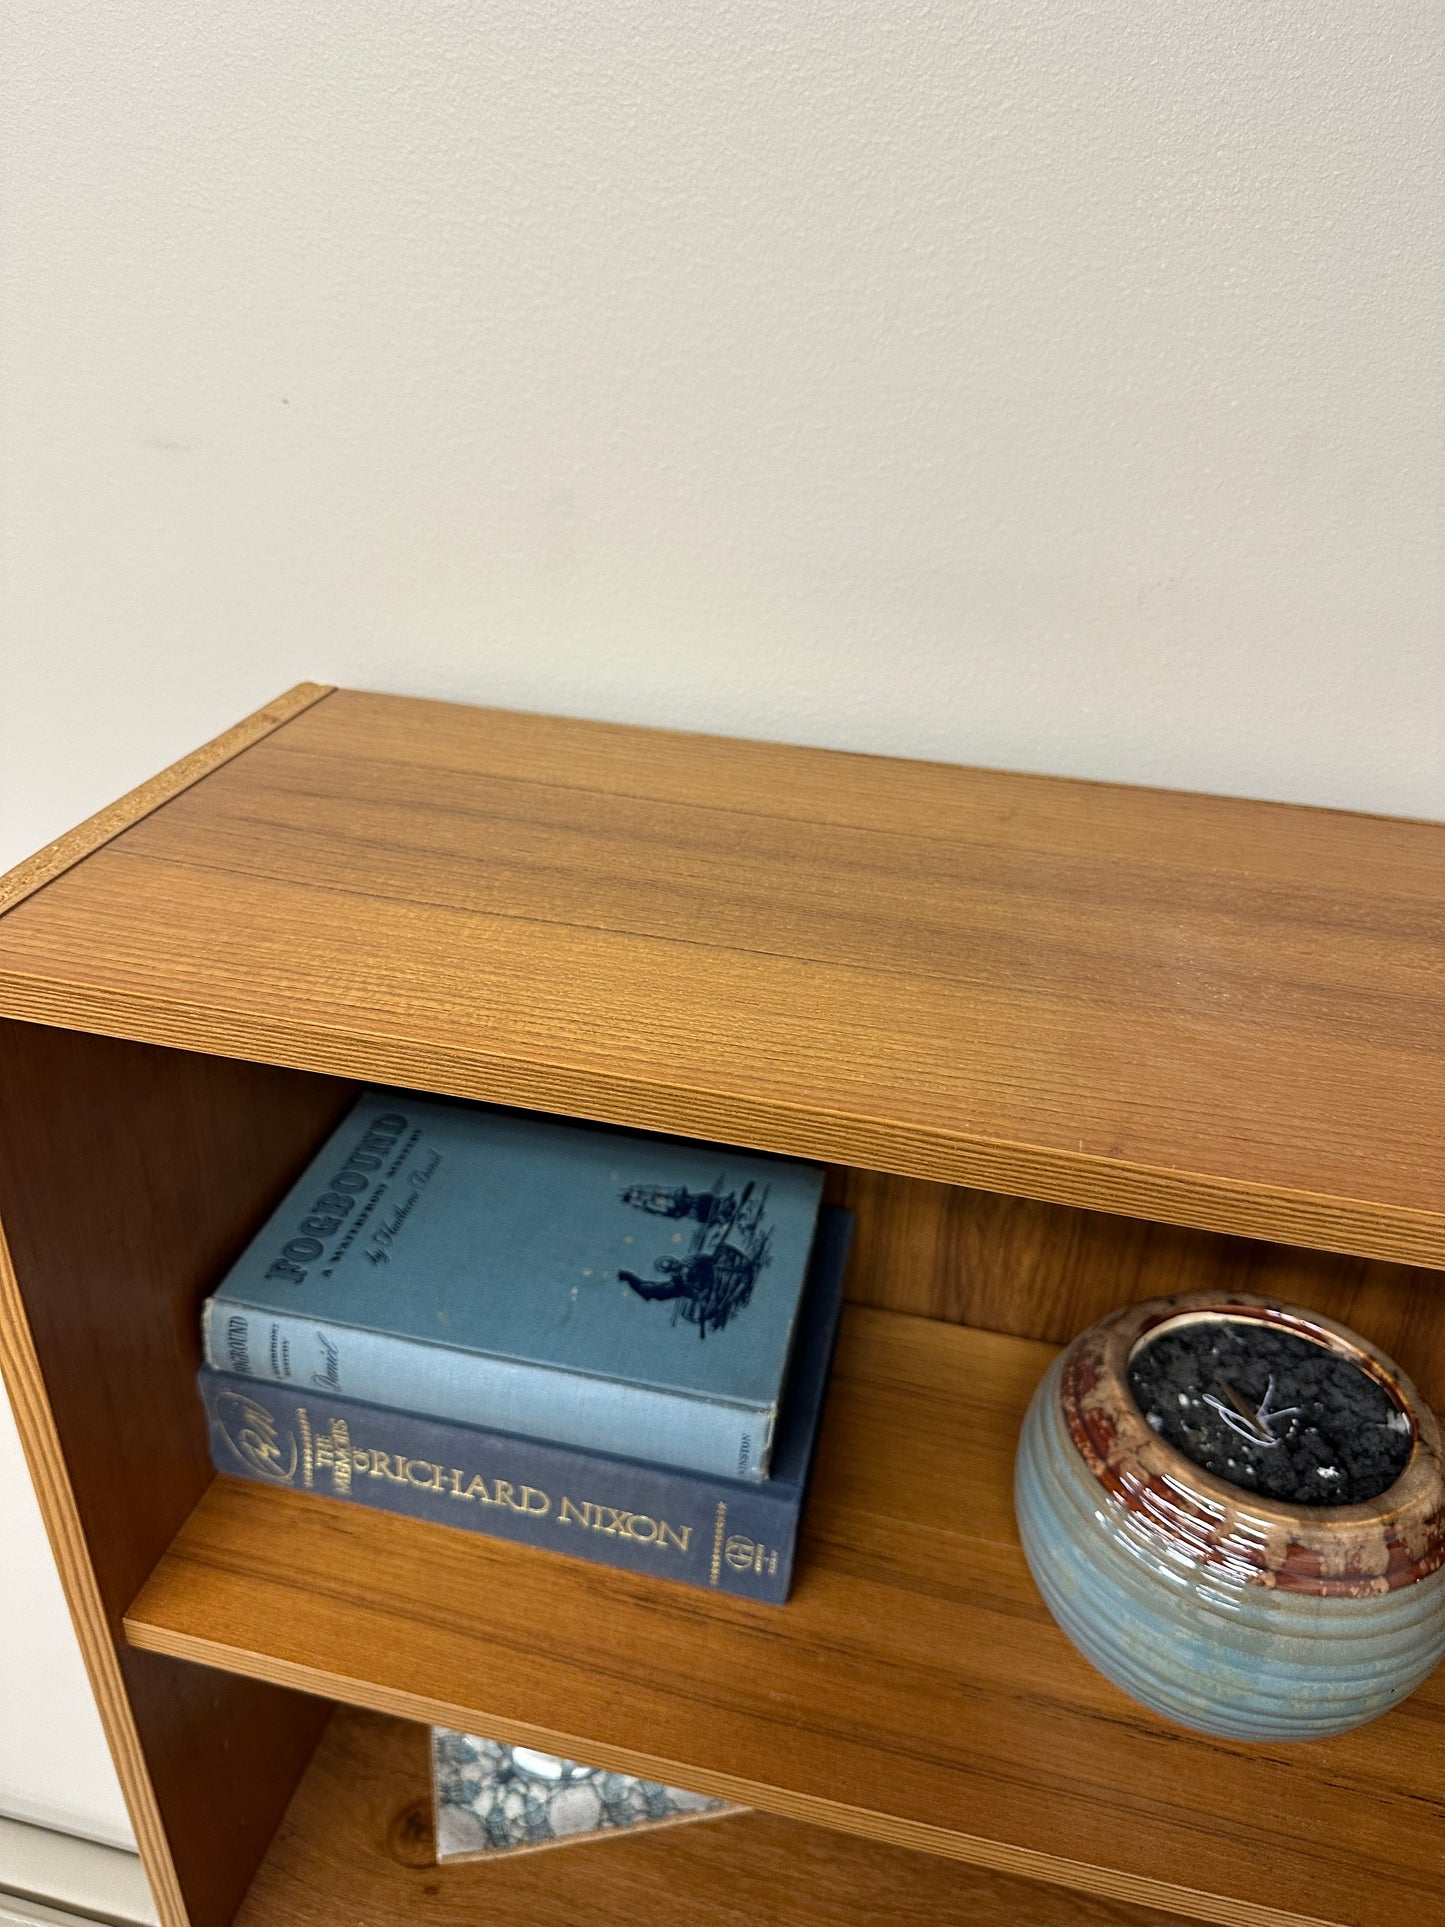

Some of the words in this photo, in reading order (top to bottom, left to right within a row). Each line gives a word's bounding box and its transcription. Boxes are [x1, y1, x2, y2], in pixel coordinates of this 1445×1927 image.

[264, 1113, 409, 1285] FOGBOUND
[364, 1248, 390, 1267] by
[311, 1330, 342, 1392] Daniel
[329, 1417, 352, 1494] MEMOIRS
[368, 1447, 552, 1516] RICHARD
[557, 1496, 693, 1551] NIXON
